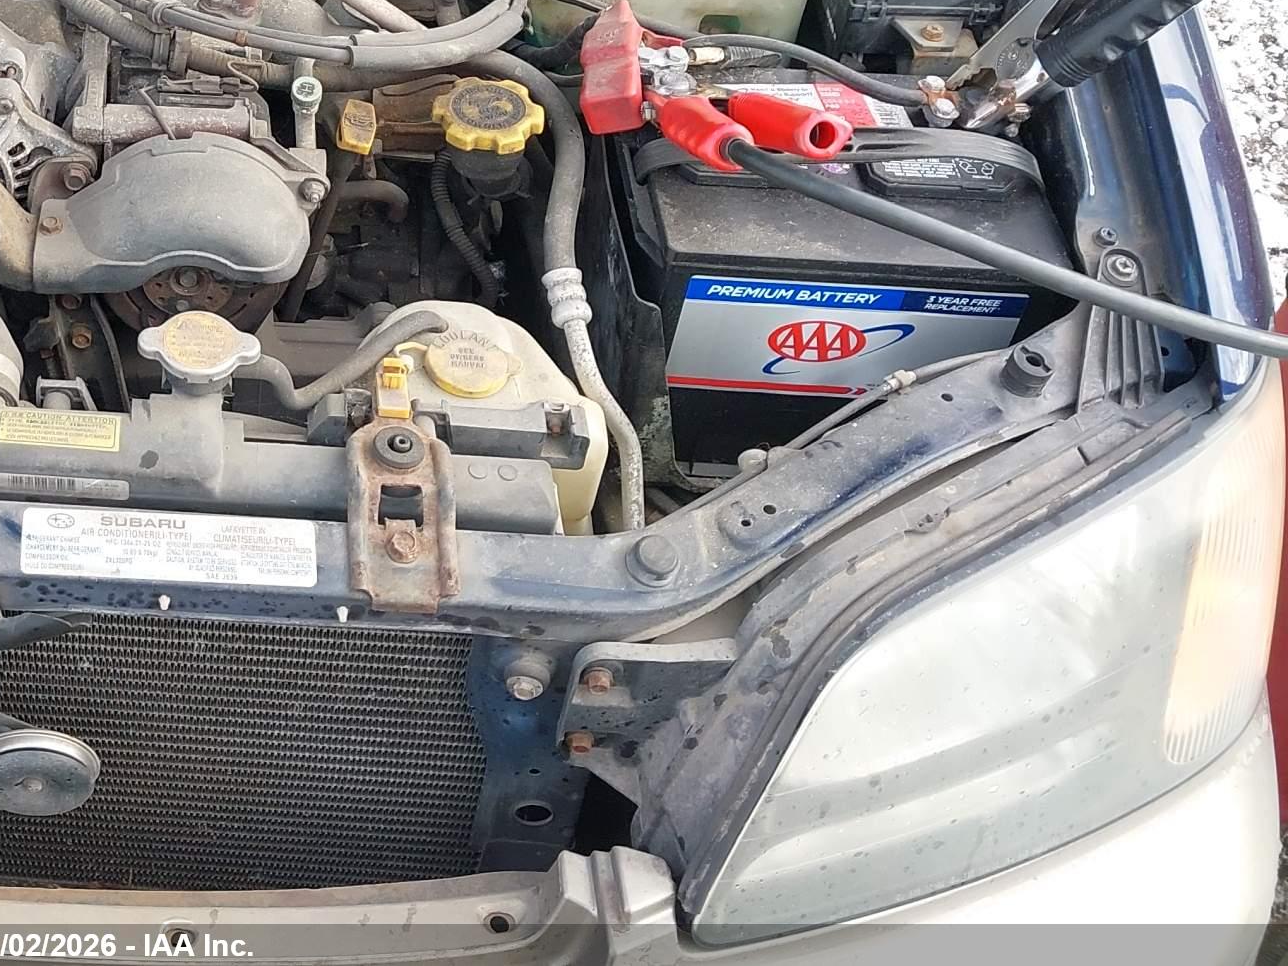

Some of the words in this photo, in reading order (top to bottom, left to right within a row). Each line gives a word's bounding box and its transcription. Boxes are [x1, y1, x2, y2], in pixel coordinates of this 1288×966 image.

[707, 285, 794, 300] PREMIUM
[795, 290, 881, 305] BATTERY
[927, 295, 936, 304] 3
[937, 296, 968, 305] YEAR
[970, 299, 1004, 307] FREE
[432, 330, 499, 351] COOLANT
[777, 321, 854, 362] AAA
[26, 412, 62, 421] CAUTION
[65, 415, 114, 425] ATTENTION
[100, 515, 186, 530] SUBARU
[81, 527, 95, 537] AIR
